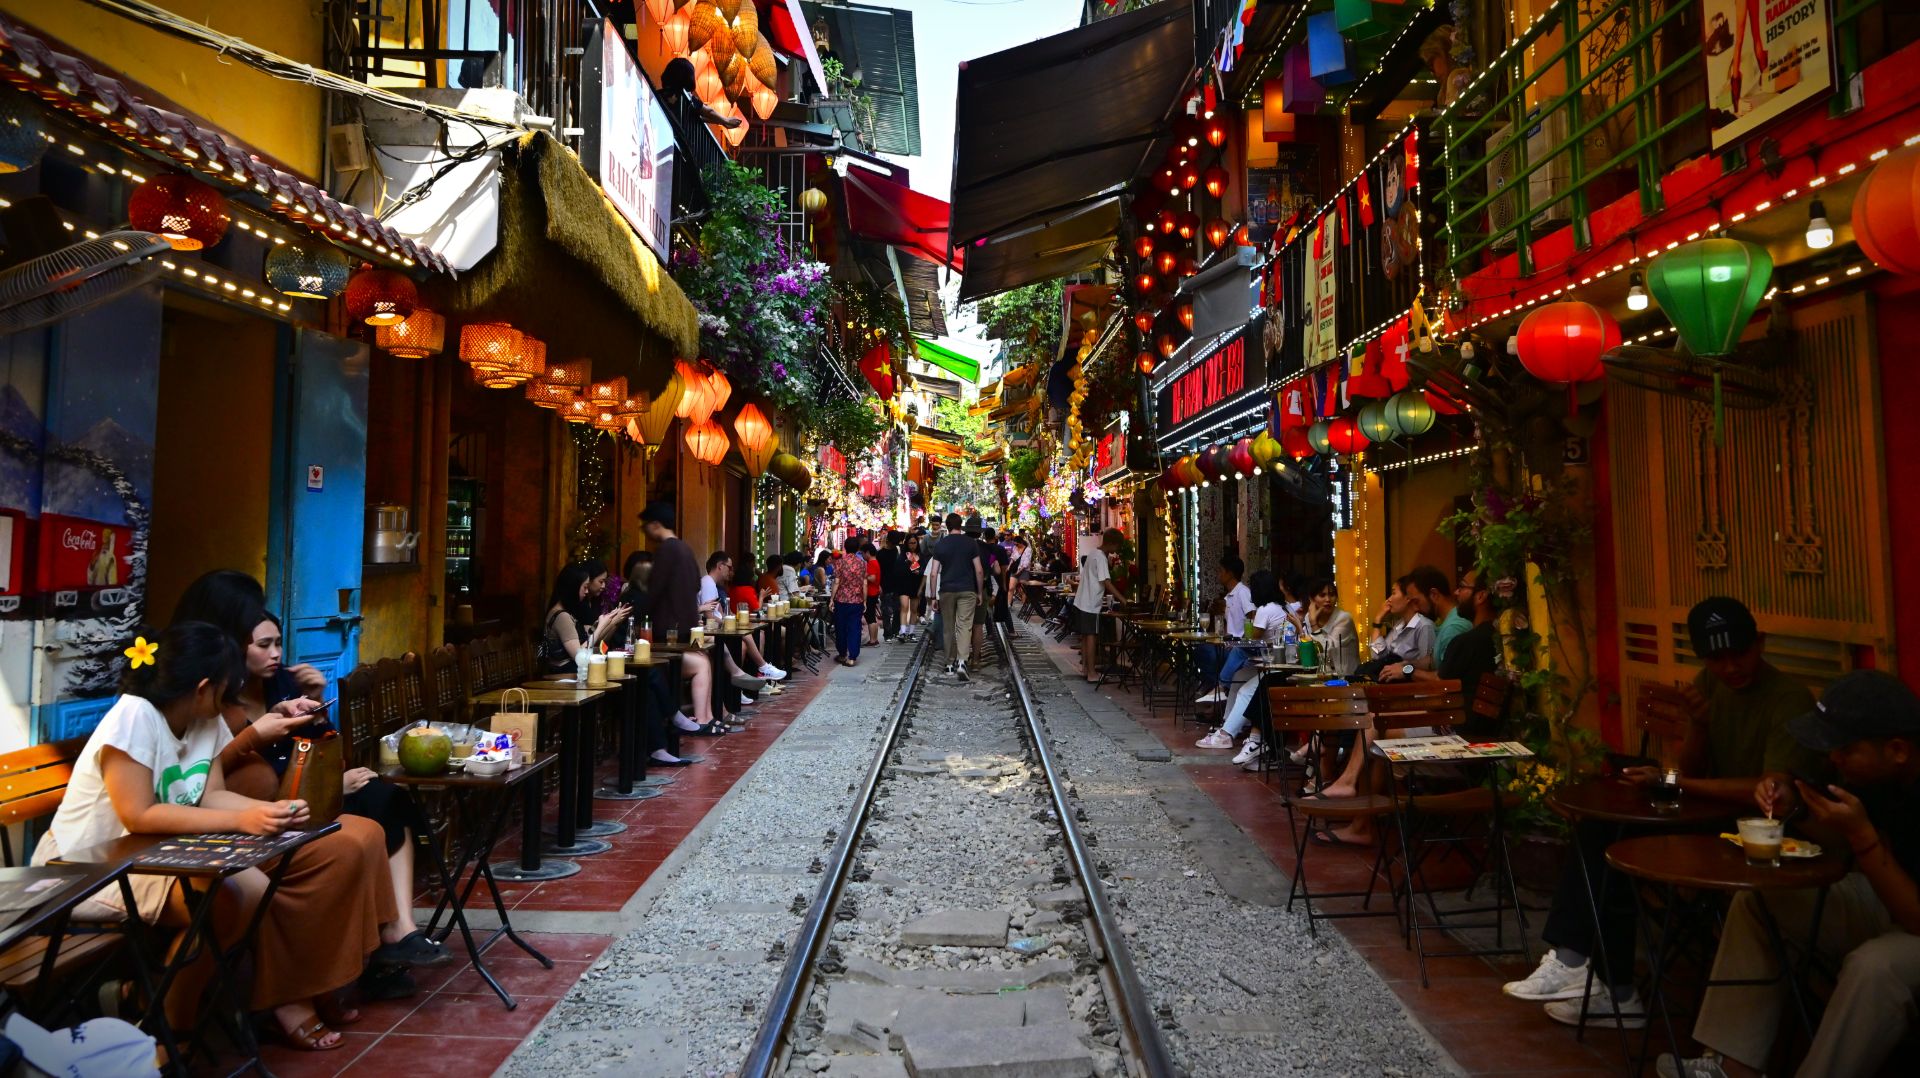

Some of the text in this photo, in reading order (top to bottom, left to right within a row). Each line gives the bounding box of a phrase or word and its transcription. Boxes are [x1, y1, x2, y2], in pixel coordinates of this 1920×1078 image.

[1765, 0, 1817, 44] HISTORY
[608, 149, 647, 223] RAILWAY
[1204, 347, 1228, 408] SINCE
